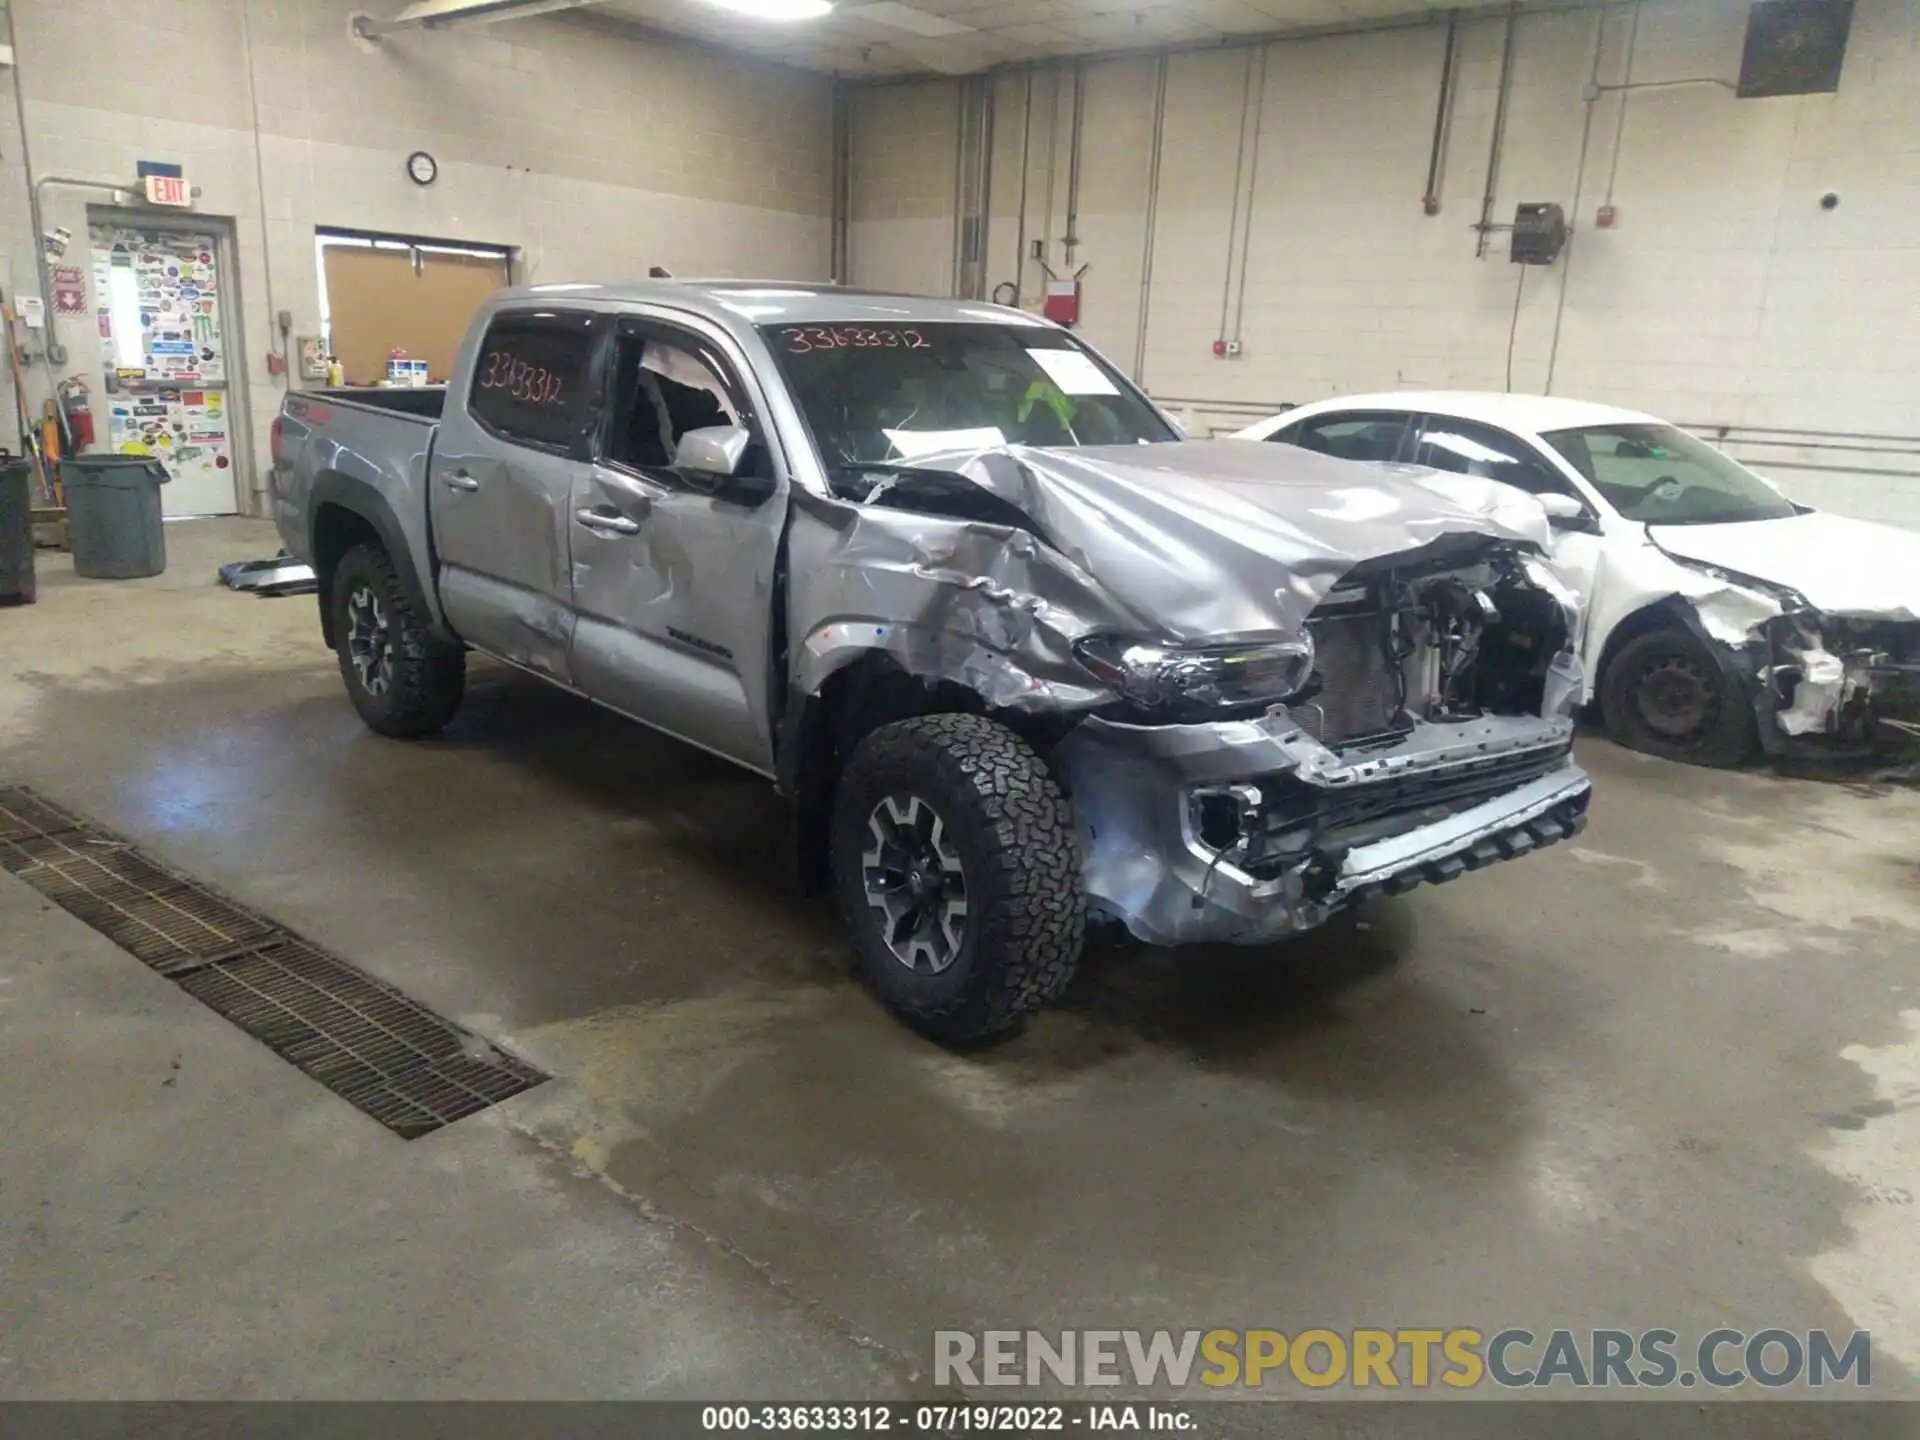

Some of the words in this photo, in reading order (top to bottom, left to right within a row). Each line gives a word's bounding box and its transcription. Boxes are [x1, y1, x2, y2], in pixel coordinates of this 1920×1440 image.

[154, 178, 184, 202] EXIT
[780, 327, 931, 353] 33633312
[481, 352, 565, 405] 33633312
